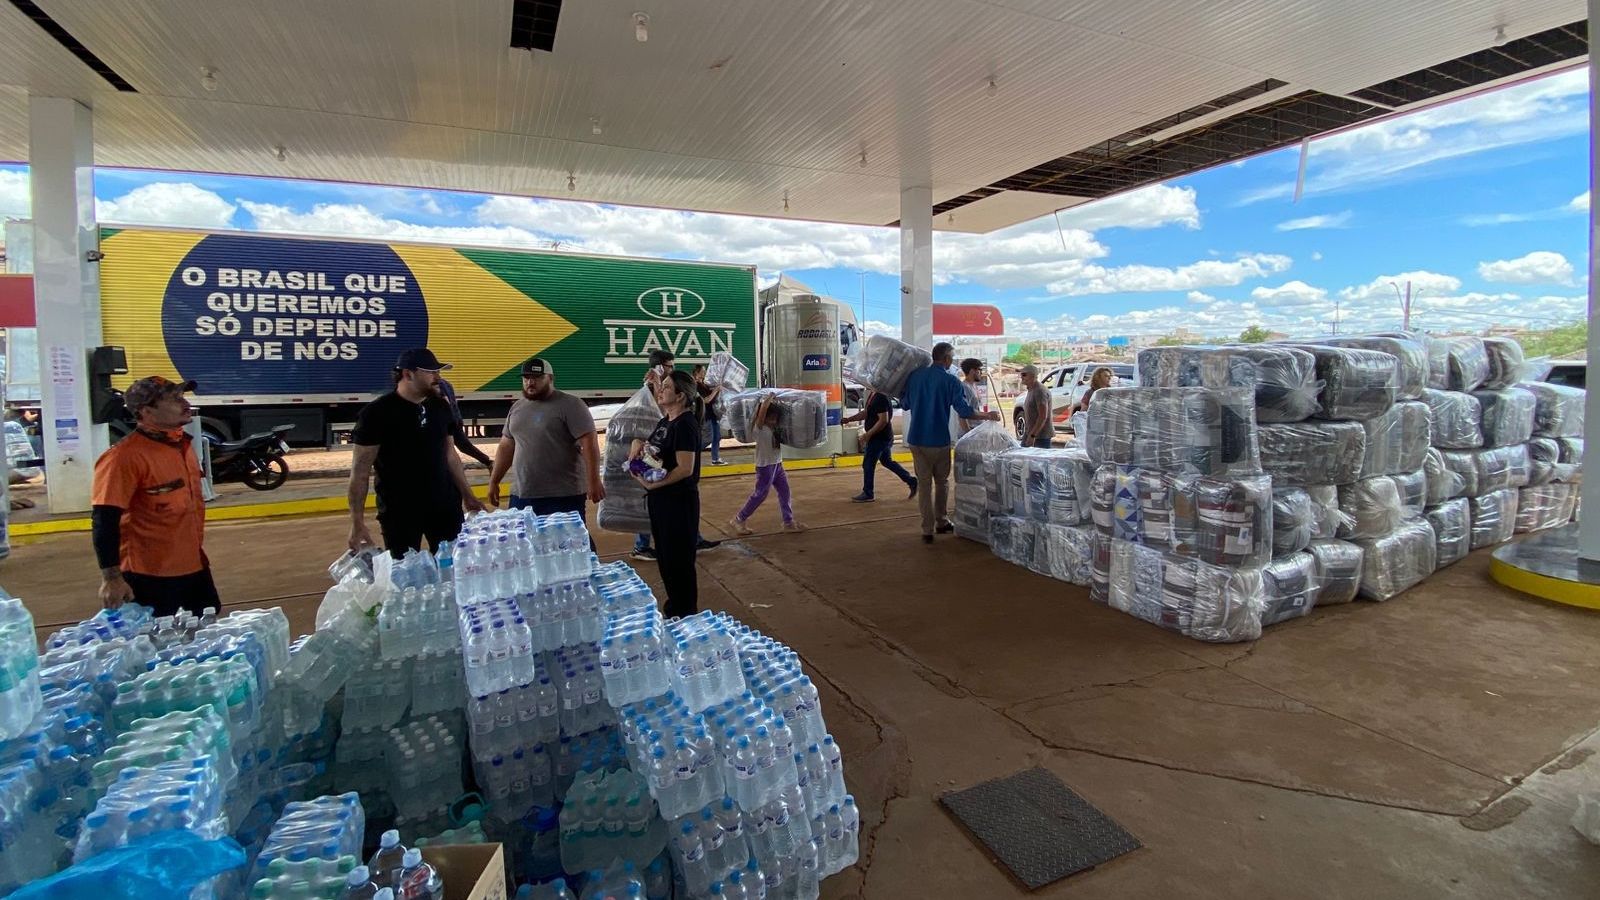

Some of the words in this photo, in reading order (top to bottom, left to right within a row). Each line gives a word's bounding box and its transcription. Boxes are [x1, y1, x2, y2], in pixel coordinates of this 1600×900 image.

[182, 266, 207, 287] O
[218, 268, 335, 290] BRASIL
[344, 273, 406, 293] QUE
[206, 292, 387, 315] QUEREMOS
[659, 291, 685, 316] H
[195, 312, 242, 336] SÓ
[252, 317, 397, 338] DEPENDE
[983, 311, 993, 328] 3
[240, 341, 283, 361] DE
[293, 338, 359, 361] NÓS
[605, 327, 735, 356] HAVAN
